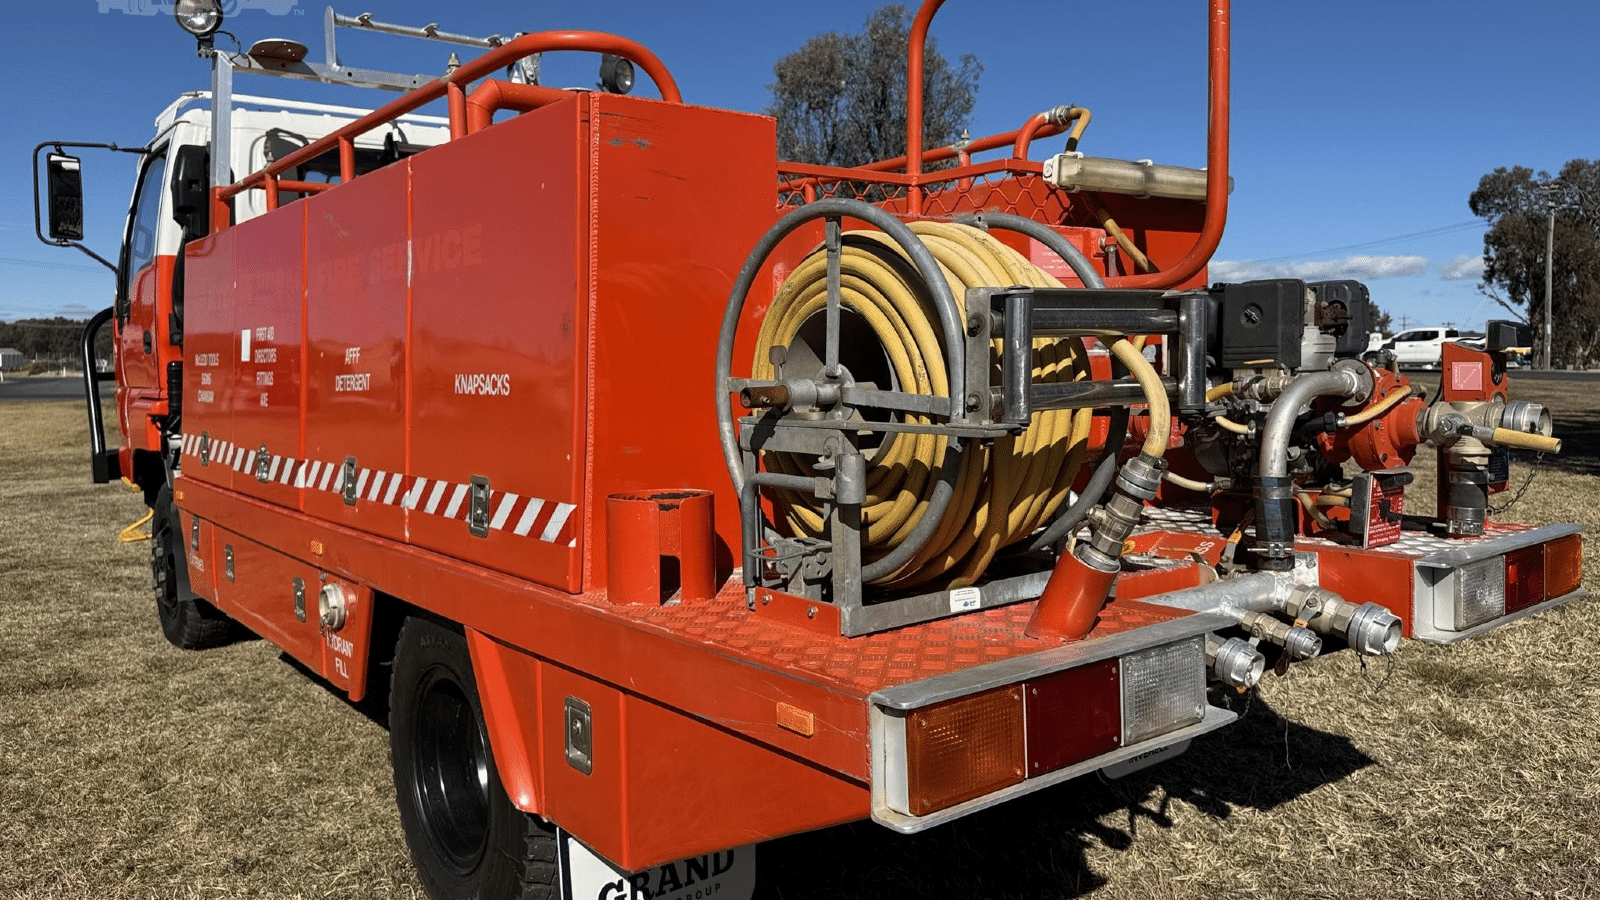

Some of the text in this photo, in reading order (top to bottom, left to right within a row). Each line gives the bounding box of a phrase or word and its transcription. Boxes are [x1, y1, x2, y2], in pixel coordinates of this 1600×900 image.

[345, 347, 361, 365] AFFF
[335, 373, 371, 392] DETERGENT
[454, 373, 511, 396] KNAPSACKS
[335, 656, 350, 679] FILL
